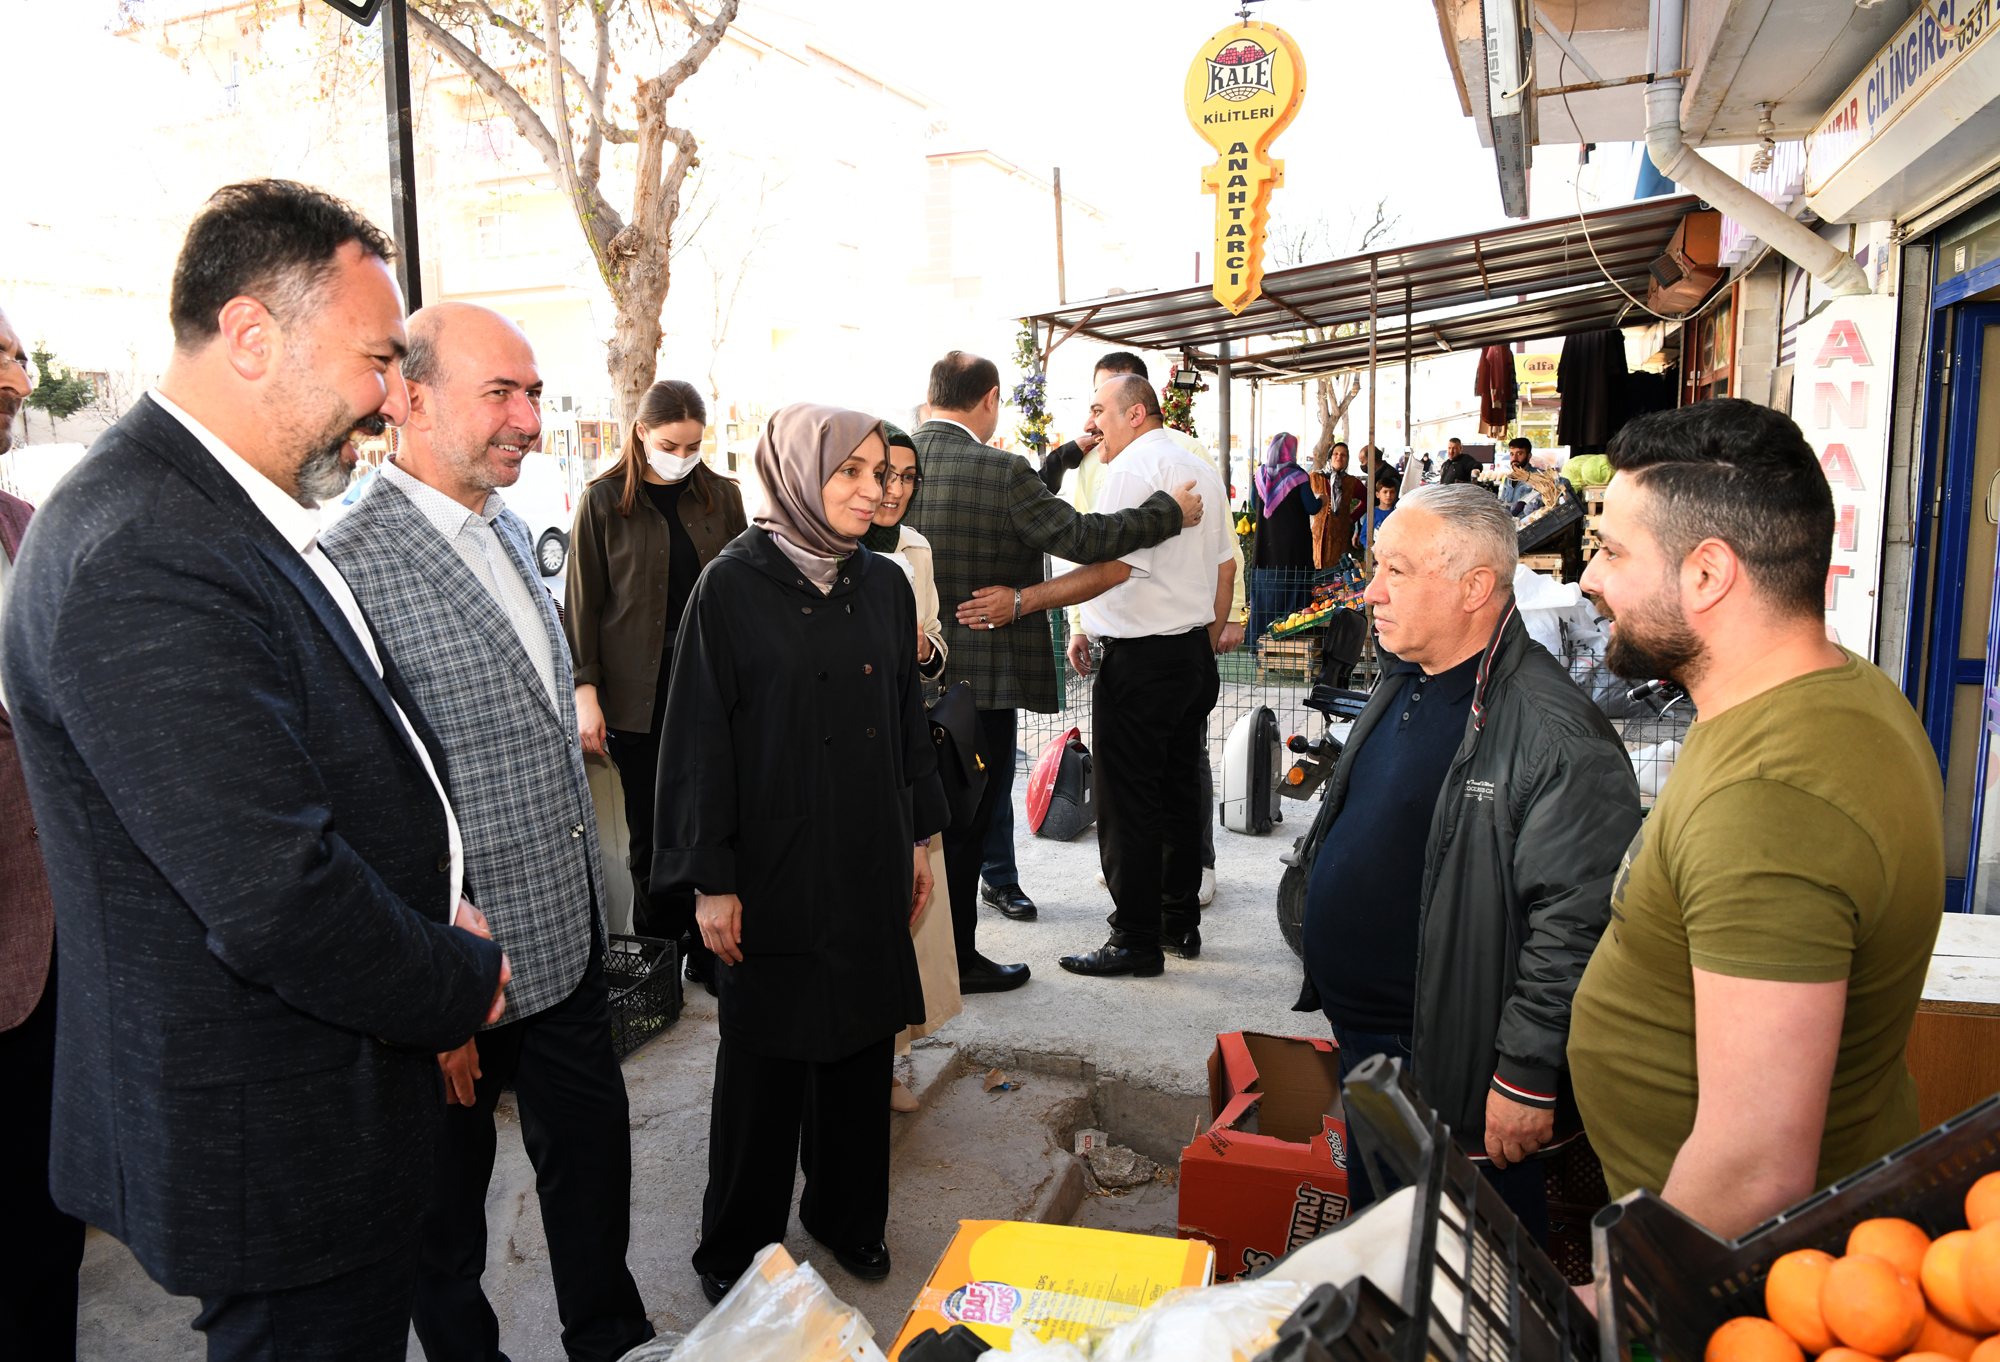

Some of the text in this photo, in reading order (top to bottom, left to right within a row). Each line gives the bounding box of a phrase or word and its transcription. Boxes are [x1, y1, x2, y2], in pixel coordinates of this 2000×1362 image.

[1211, 58, 1269, 93] KALE
[1204, 105, 1274, 124] KİLİTLERİ
[1226, 142, 1249, 286] ANAHTARCI
[1528, 361, 1555, 371] alfa
[1814, 319, 1872, 645] ANAHT
[1290, 1190, 1322, 1250] ANTAJ
